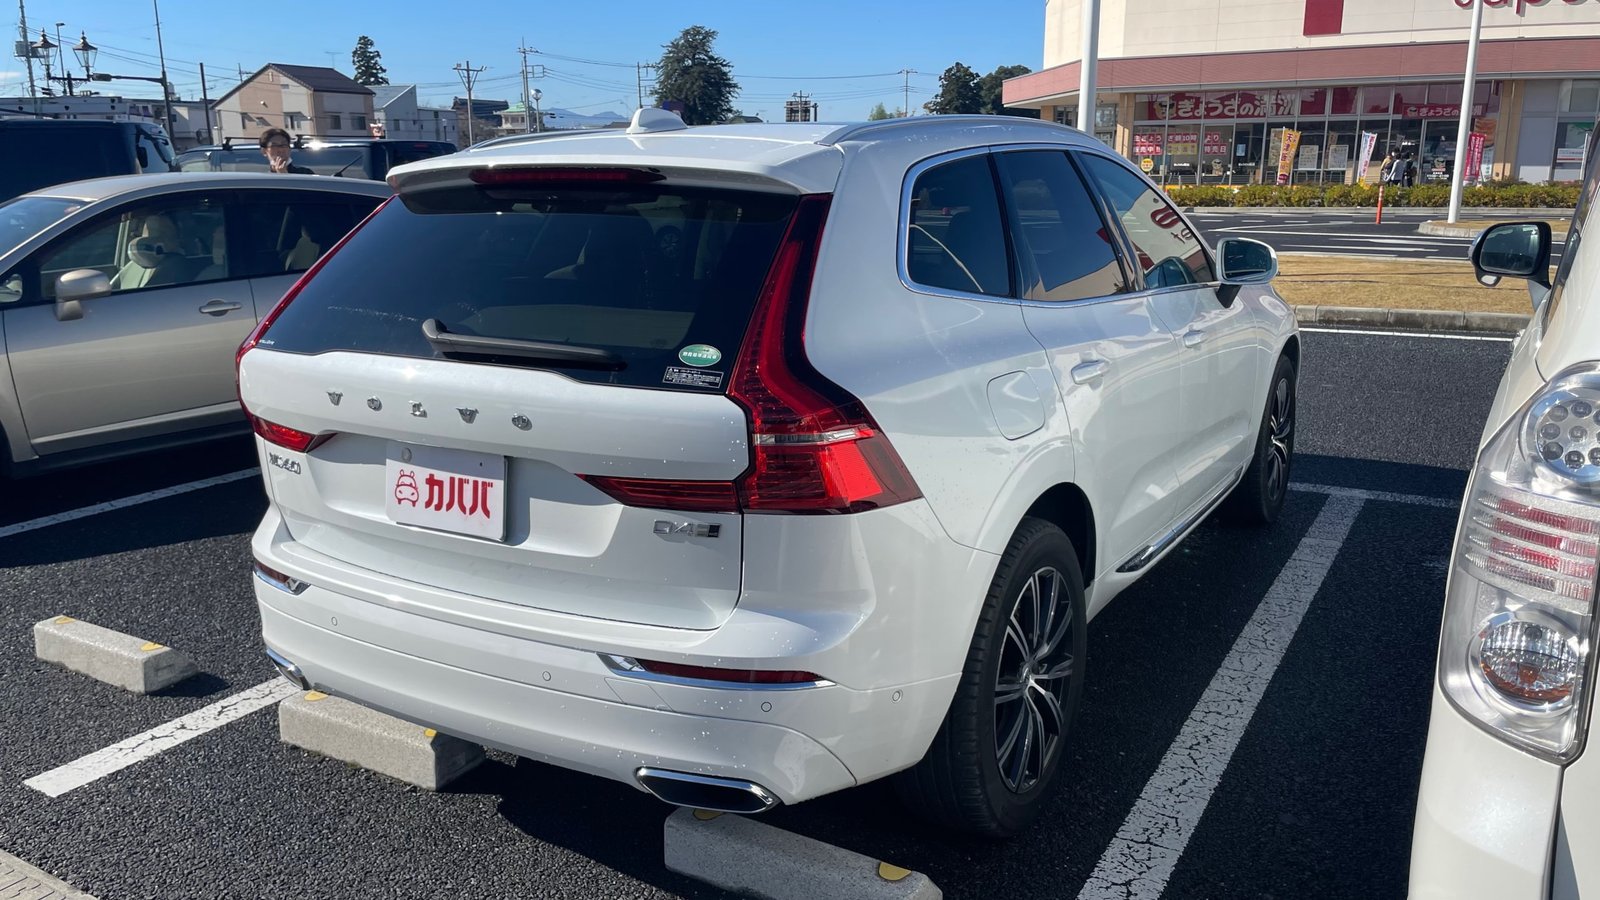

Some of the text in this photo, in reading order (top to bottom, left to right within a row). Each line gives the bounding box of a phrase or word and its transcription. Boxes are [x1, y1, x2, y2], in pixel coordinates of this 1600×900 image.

[1419, 105, 1482, 117] ぎょうざの洲
[327, 391, 533, 431] VOLVO
[424, 473, 494, 519] カババ
